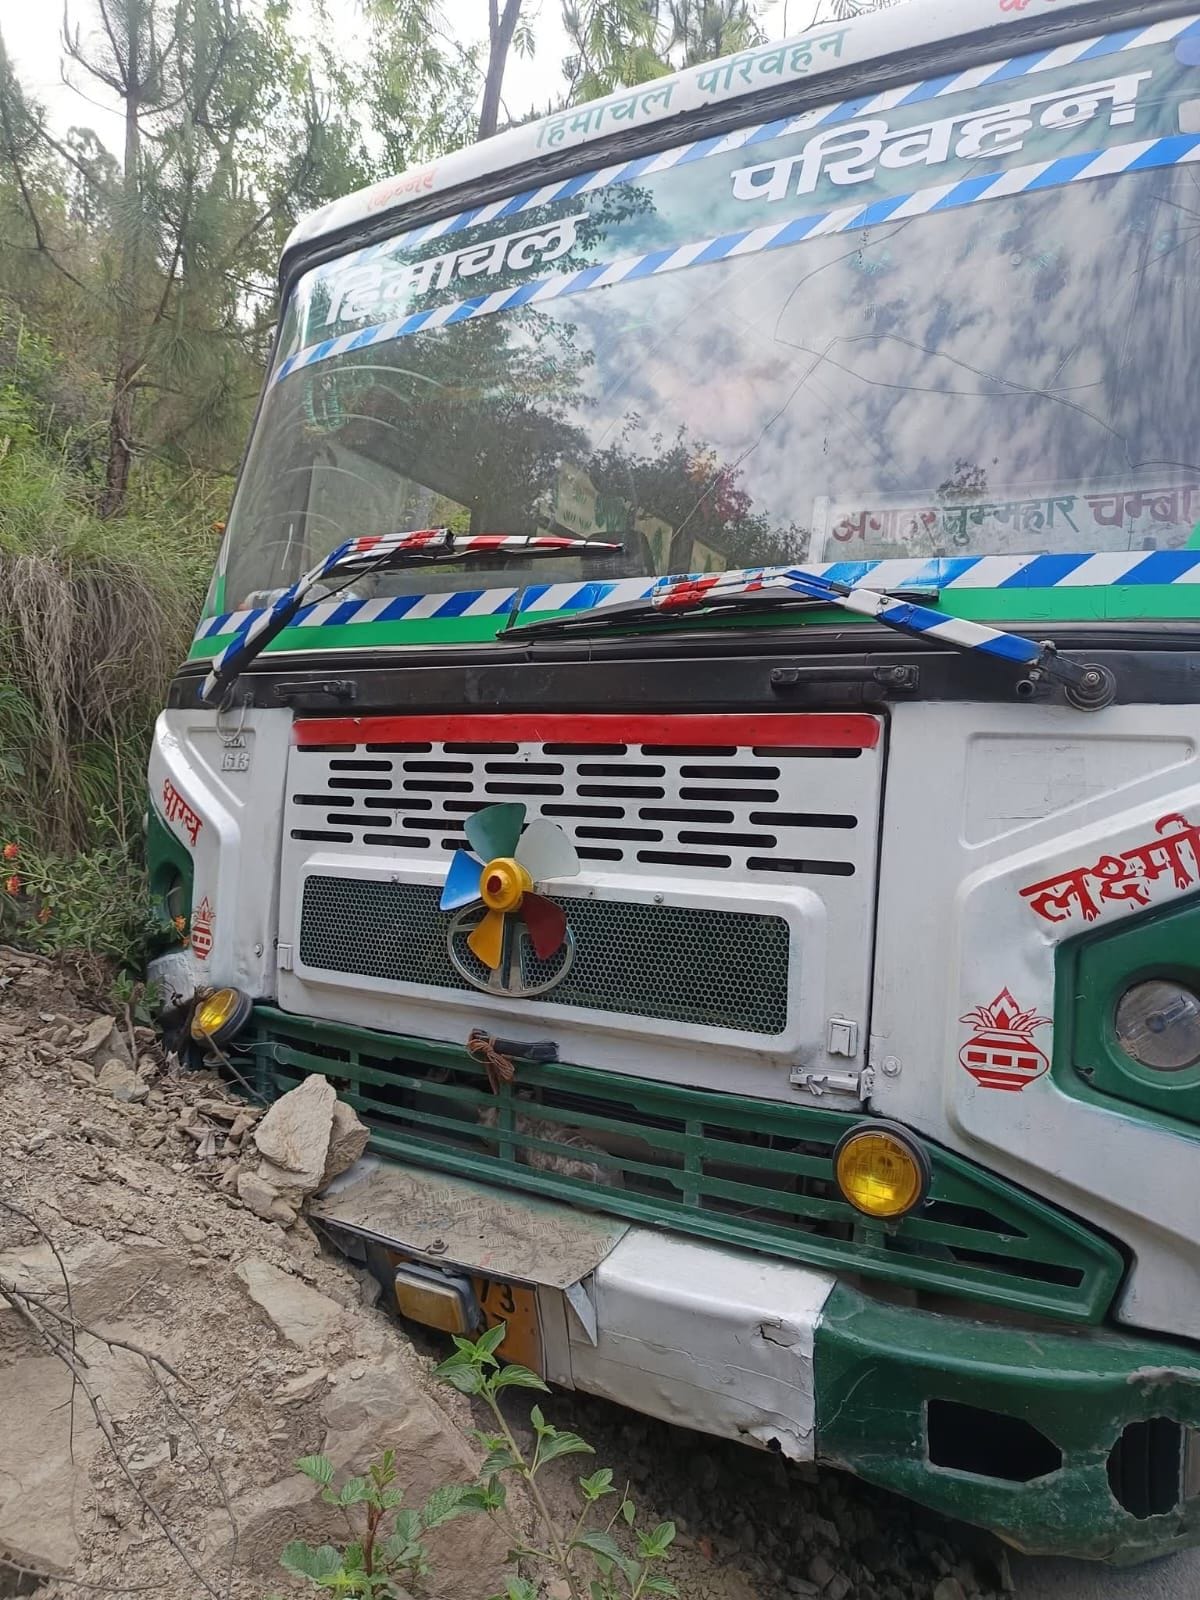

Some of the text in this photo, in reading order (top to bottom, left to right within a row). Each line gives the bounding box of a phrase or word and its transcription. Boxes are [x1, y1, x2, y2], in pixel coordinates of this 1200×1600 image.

[536, 26, 853, 150] हिमाचल परिवहन
[325, 70, 1153, 326] हिमाचल परिवहन
